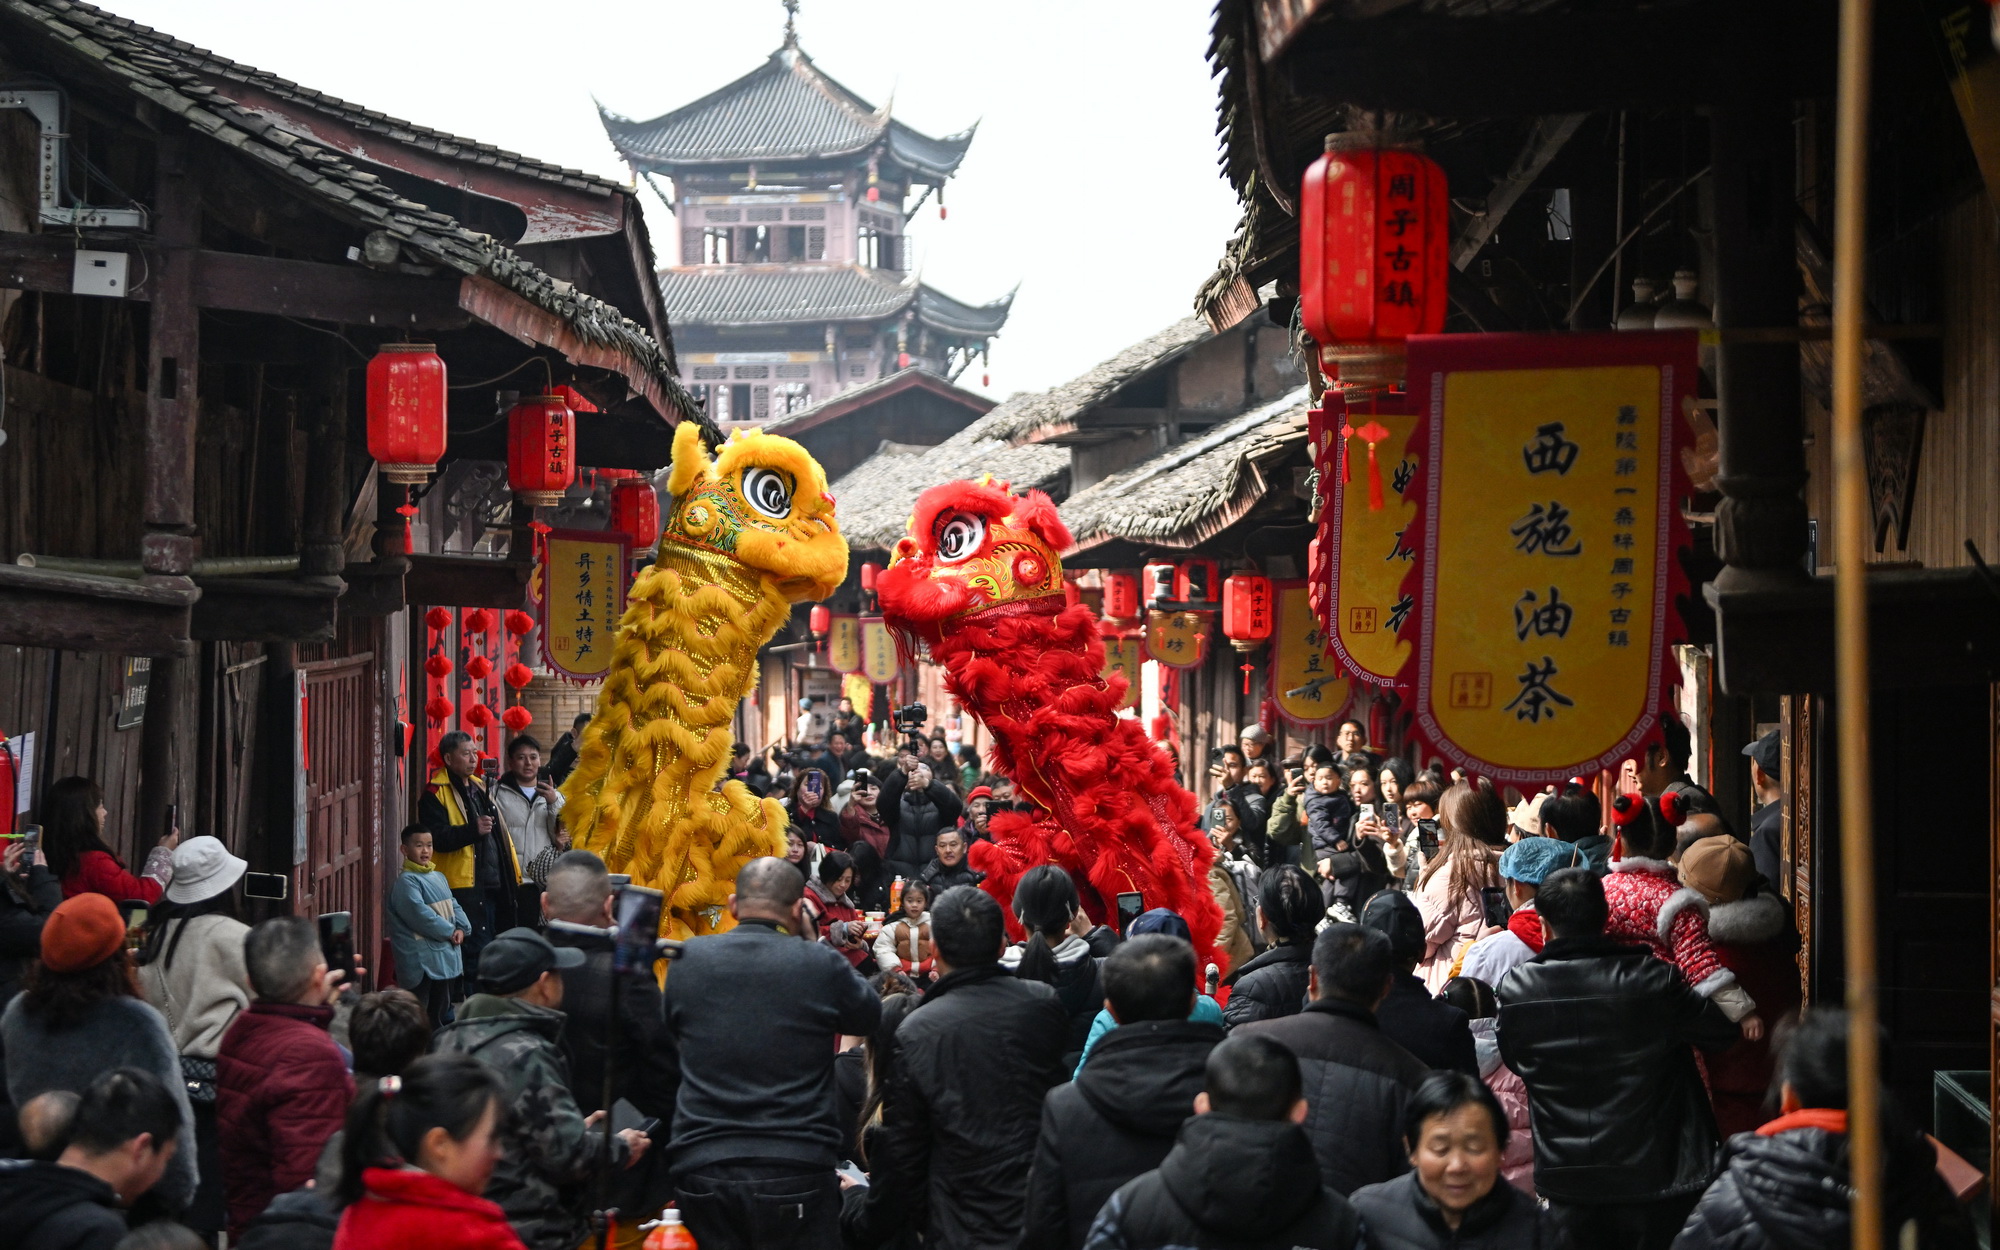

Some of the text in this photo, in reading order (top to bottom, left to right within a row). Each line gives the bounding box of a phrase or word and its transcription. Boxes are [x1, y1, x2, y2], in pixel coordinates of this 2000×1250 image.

[575, 552, 595, 662] 异乡情土特产
[1504, 422, 1582, 724] 西施油茶
